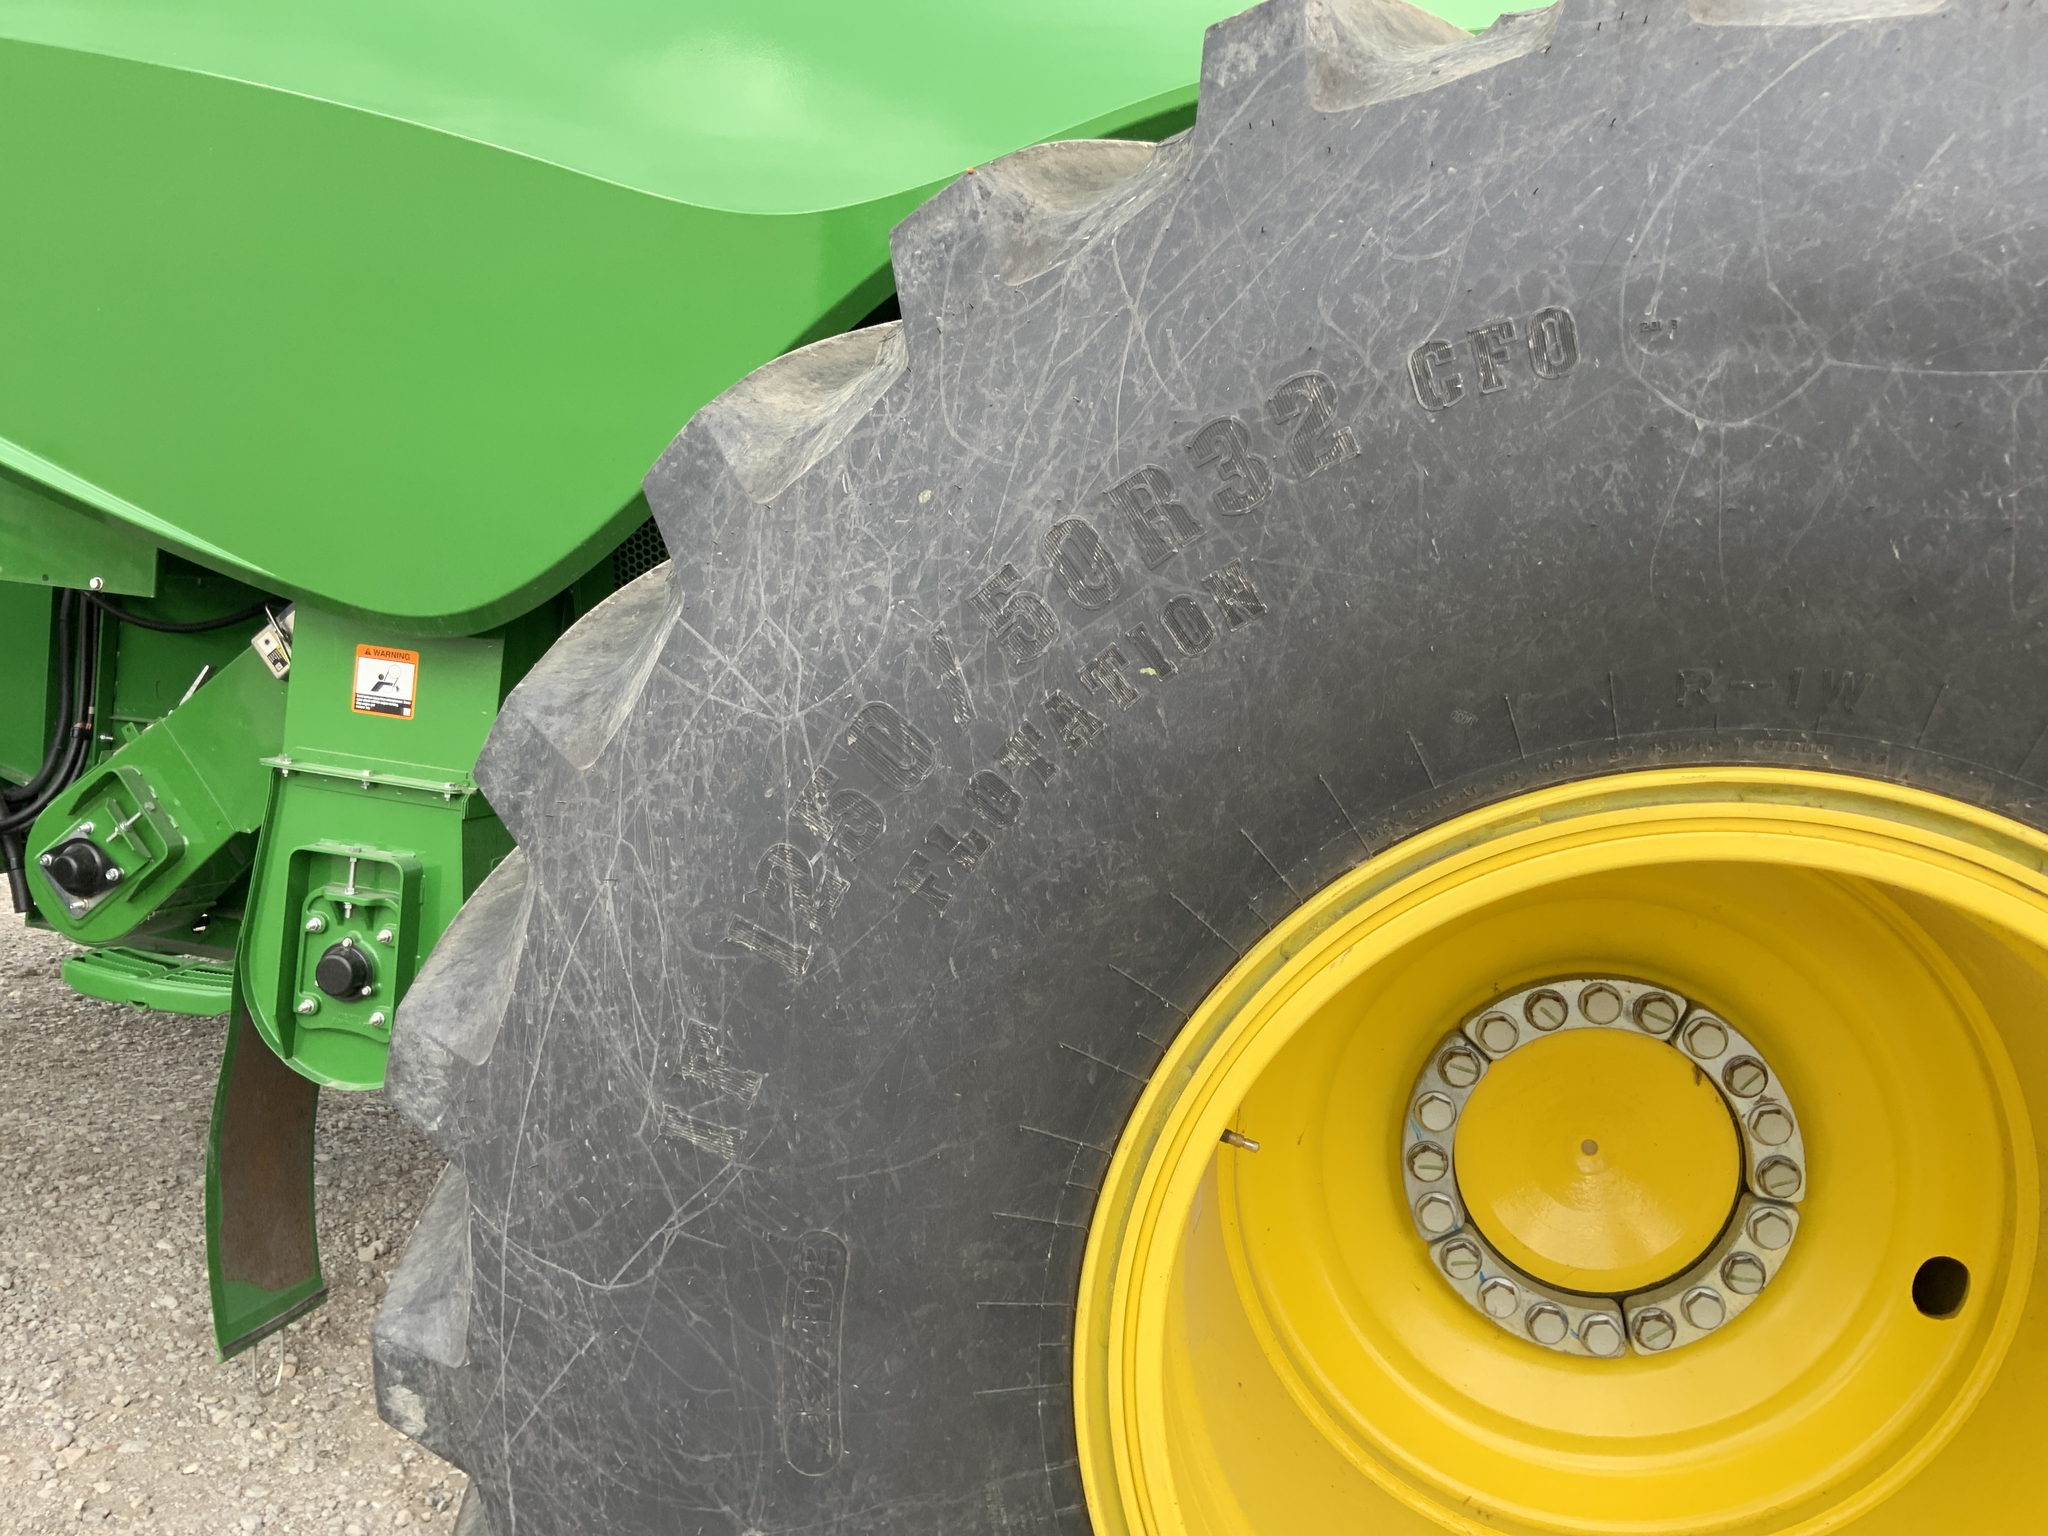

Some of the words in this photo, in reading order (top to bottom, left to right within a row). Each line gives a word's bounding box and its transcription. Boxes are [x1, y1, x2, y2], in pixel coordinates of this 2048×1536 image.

[373, 648, 411, 661] WARNING
[658, 1018, 767, 1163] IF
[722, 369, 1362, 976] 1250/50R32
[1405, 305, 1581, 412] CFO
[892, 558, 1269, 918] FLOTATION
[1364, 816, 1401, 842] MAX
[1405, 793, 1454, 821] LOAD
[1458, 783, 1480, 800] AT
